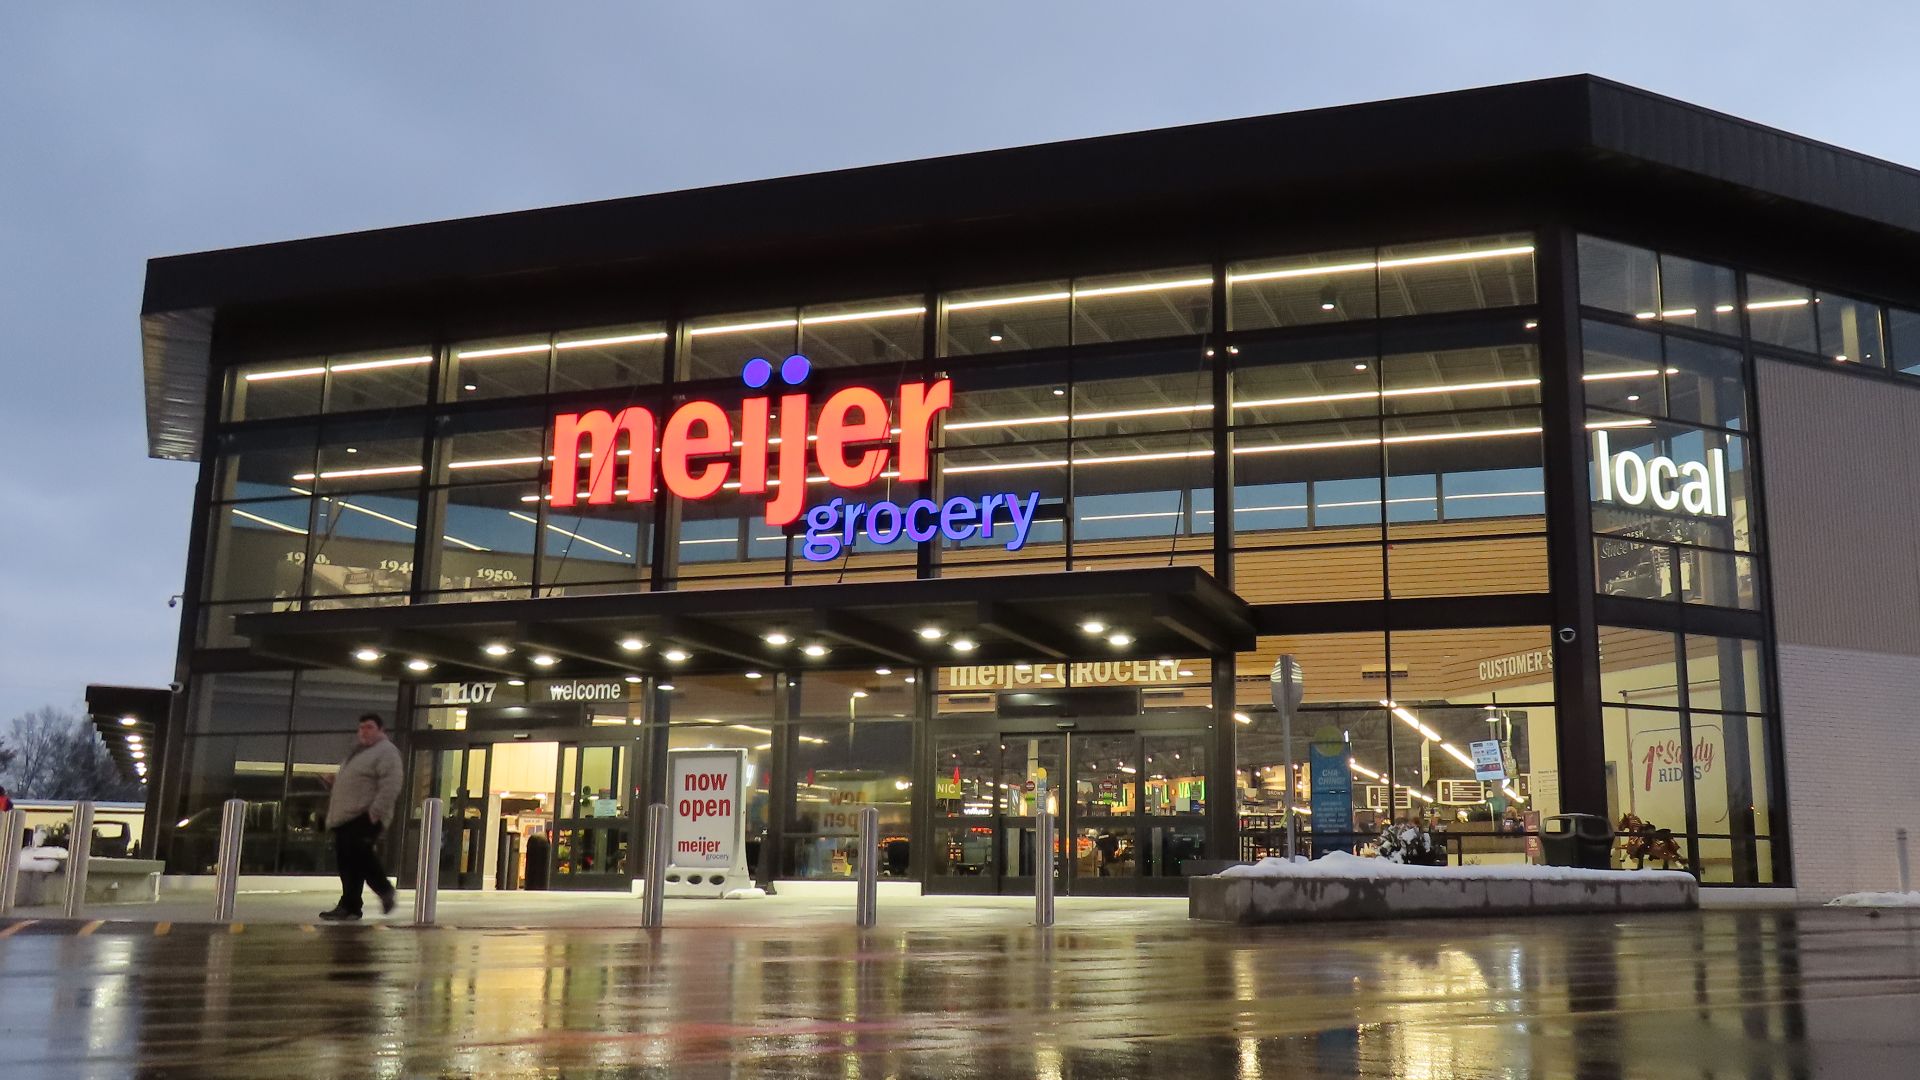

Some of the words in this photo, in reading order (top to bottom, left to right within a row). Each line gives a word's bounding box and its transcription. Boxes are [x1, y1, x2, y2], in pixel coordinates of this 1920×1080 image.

[550, 354, 952, 527] meijer
[1592, 430, 1727, 517] local
[803, 491, 1039, 562] grocery
[950, 664, 1046, 689] meijer
[1056, 660, 1182, 684] GROCERY
[1479, 651, 1543, 681] CUSTOMER
[550, 680, 621, 701] welcome
[1664, 736, 1715, 772] Sady
[684, 773, 728, 791] now
[1658, 765, 1702, 782] RIDS
[679, 799, 731, 822] open
[677, 836, 721, 856] meijer
[705, 853, 729, 861] grocery
